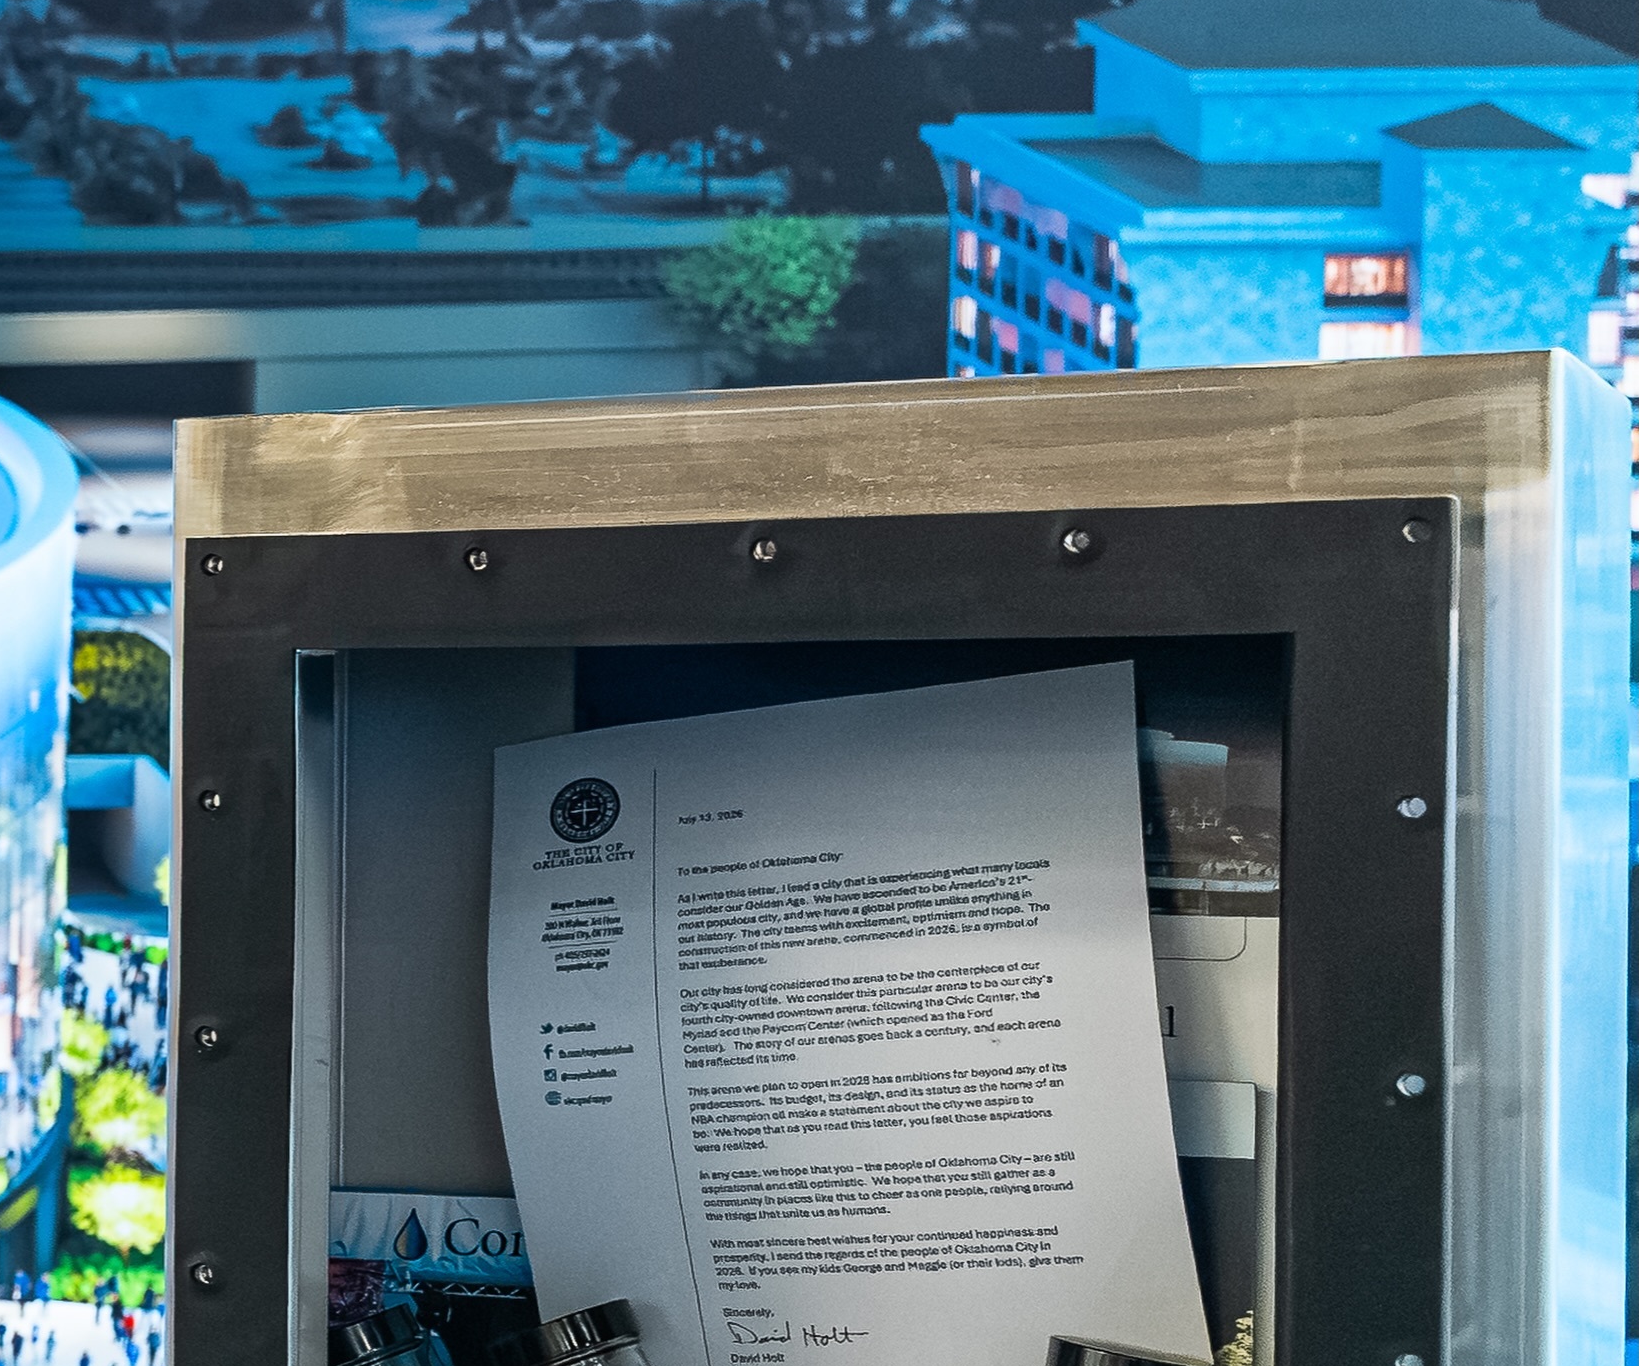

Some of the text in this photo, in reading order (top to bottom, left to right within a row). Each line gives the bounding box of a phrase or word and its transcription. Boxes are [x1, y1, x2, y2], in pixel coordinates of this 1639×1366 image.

[545, 842, 624, 859] THE CITY OF
[533, 850, 635, 871] OKLAHOMA CITY
